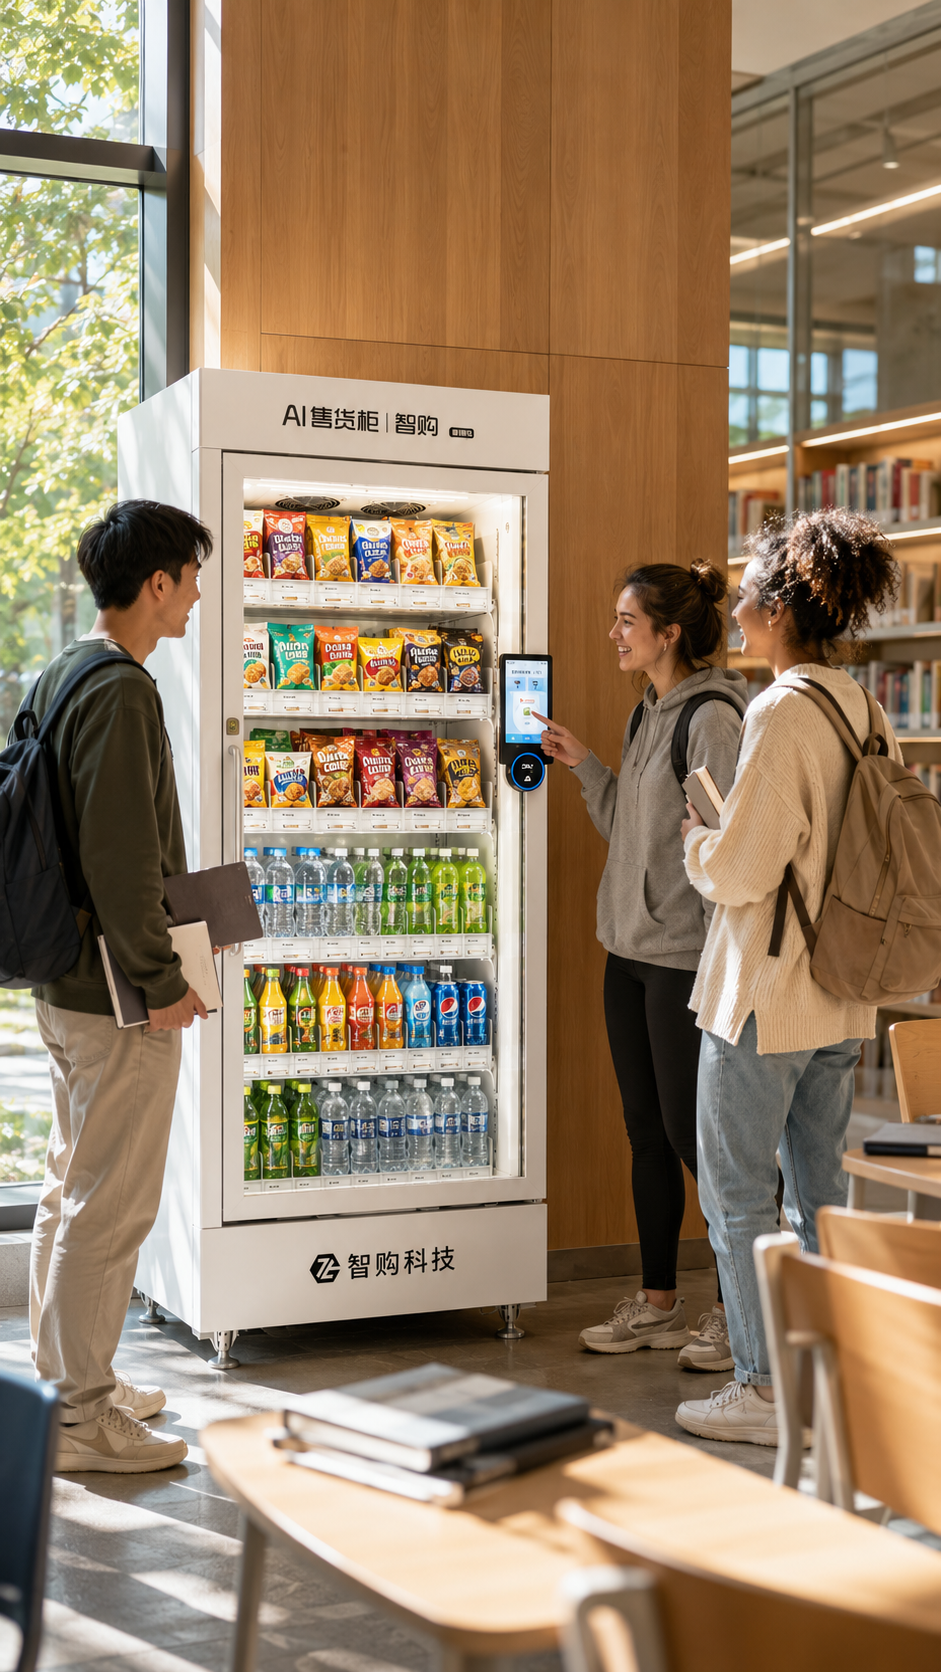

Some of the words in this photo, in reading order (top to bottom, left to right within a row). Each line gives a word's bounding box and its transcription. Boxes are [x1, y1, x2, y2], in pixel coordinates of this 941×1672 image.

[395, 413, 438, 437] 智购
[348, 1245, 455, 1279] 智购科技
